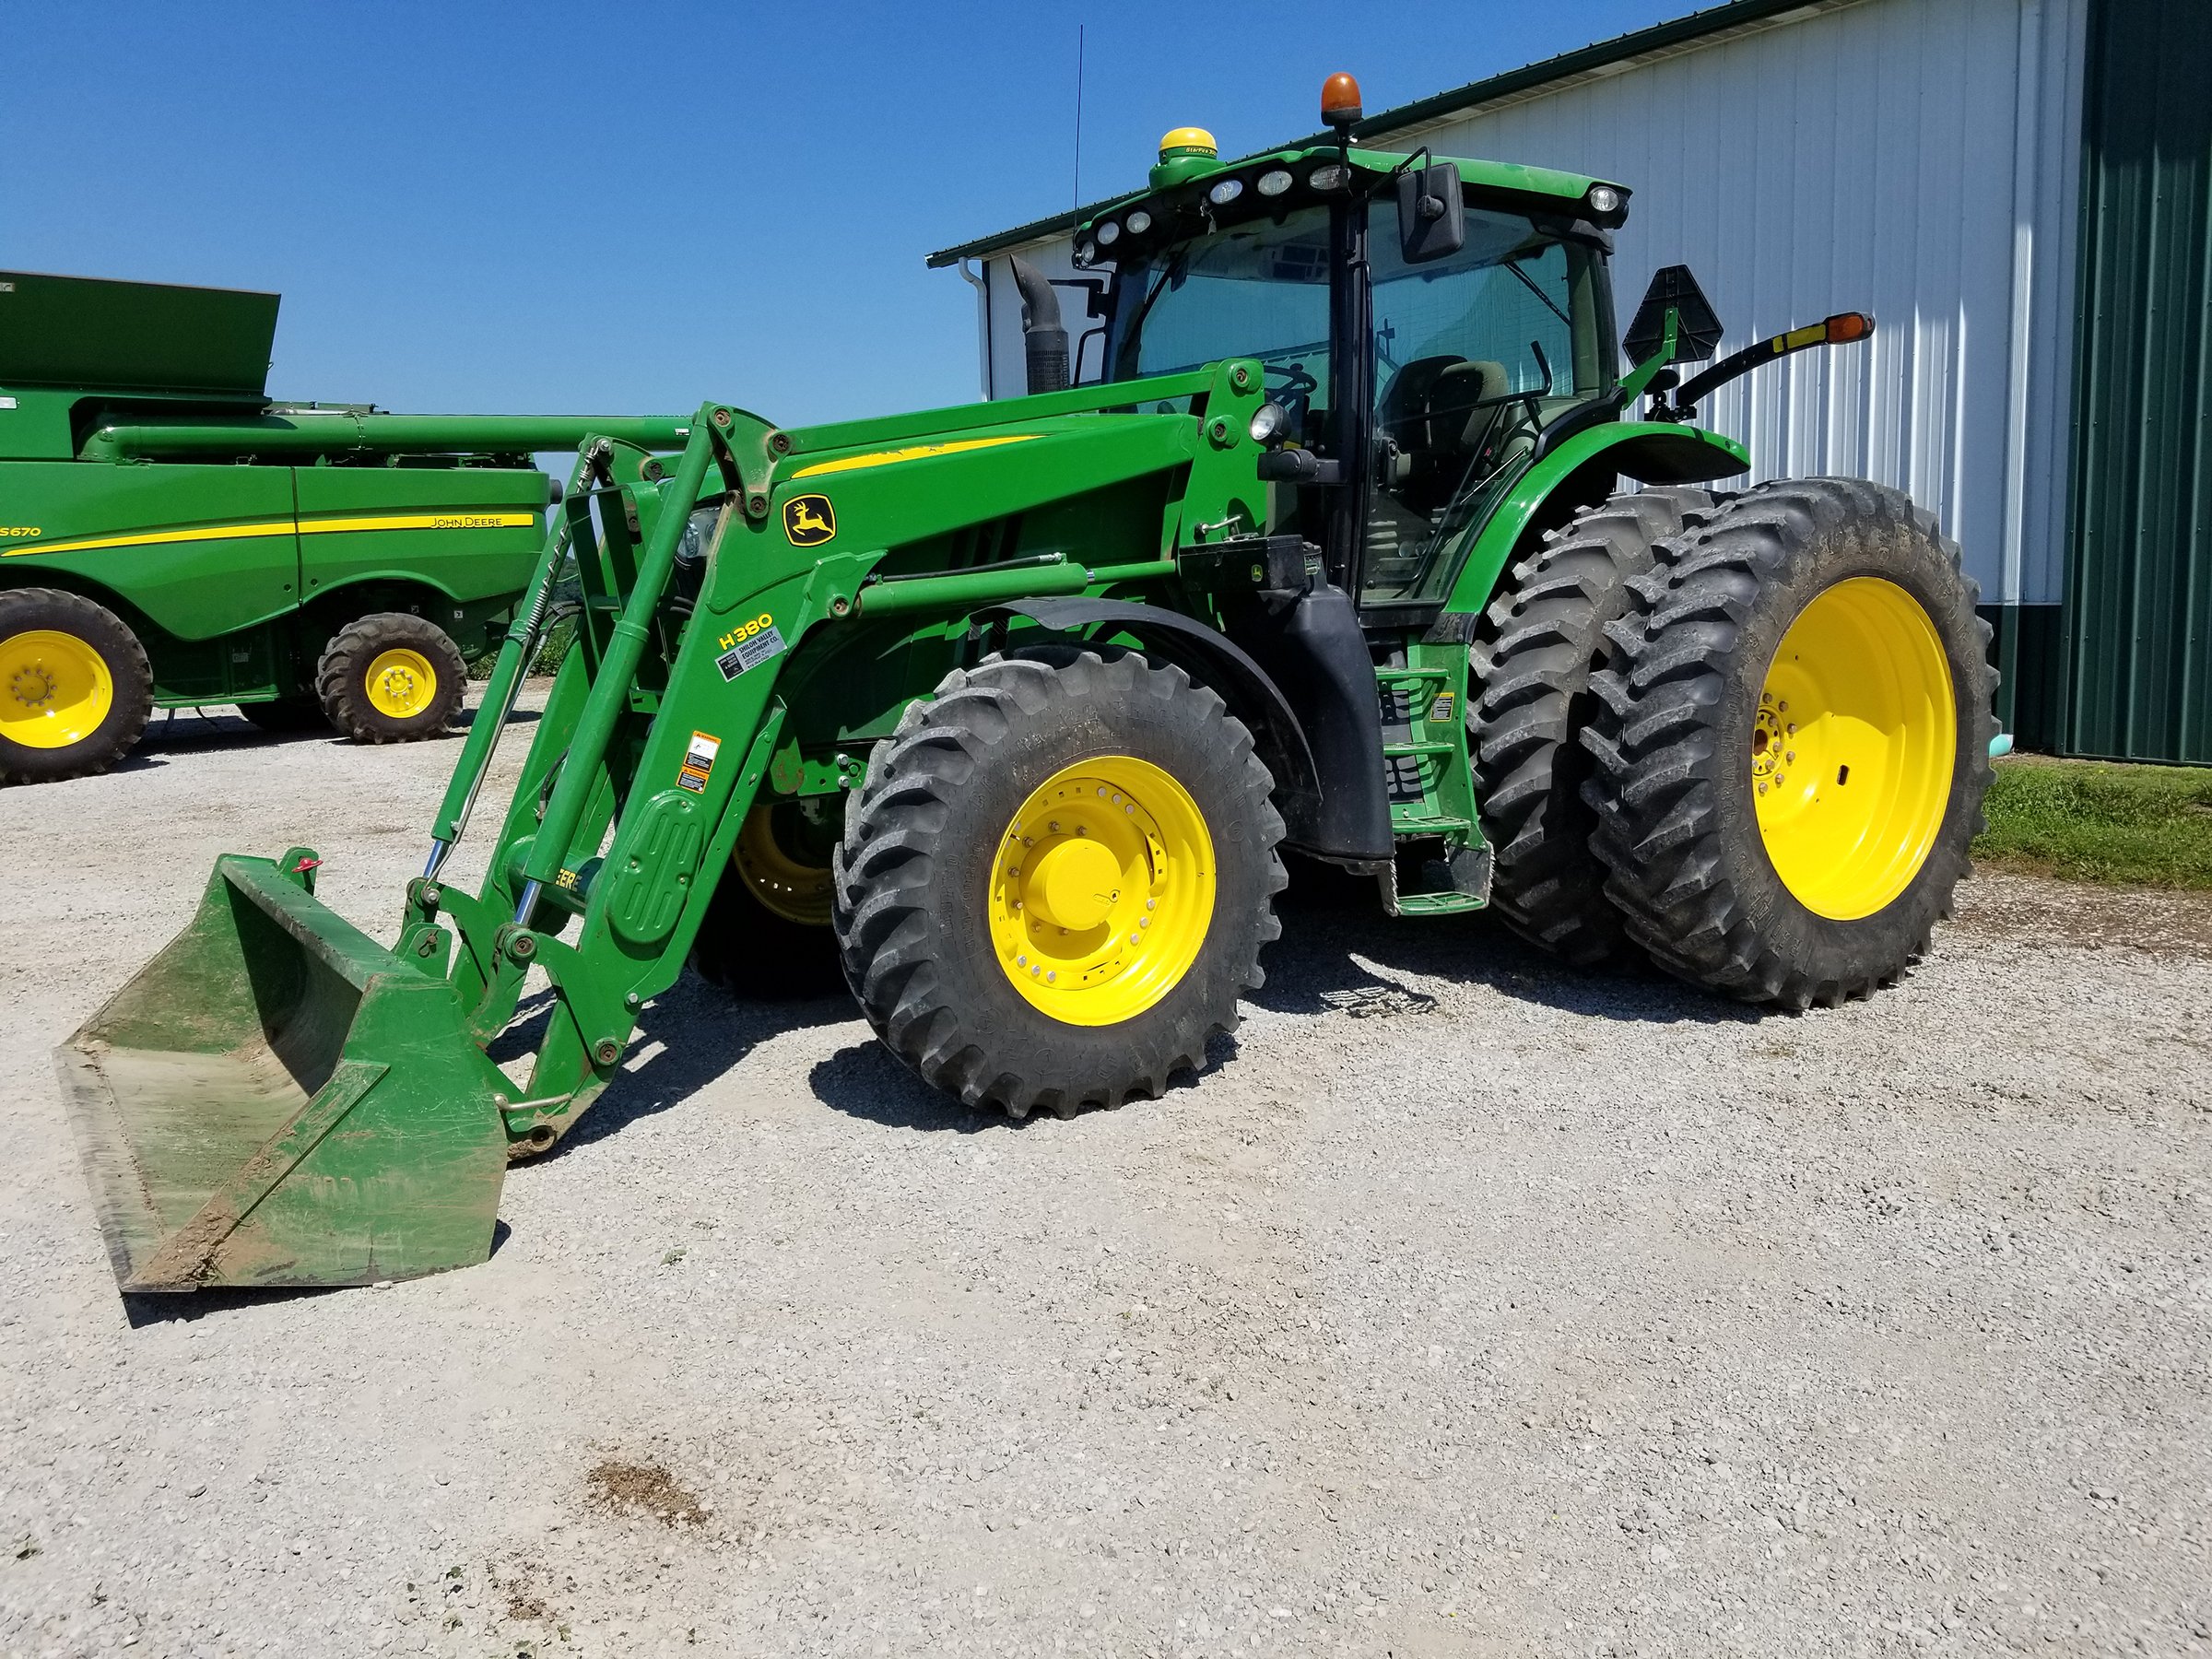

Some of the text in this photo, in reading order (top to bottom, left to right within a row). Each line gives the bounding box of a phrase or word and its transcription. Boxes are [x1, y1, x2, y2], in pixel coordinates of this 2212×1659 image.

[431, 517, 502, 527] JOHN DEERE
[0, 527, 41, 537] S670
[719, 613, 773, 651] H380
[738, 629, 774, 653] SHILOH VALLEY
[741, 641, 771, 659] EQUIPMENT
